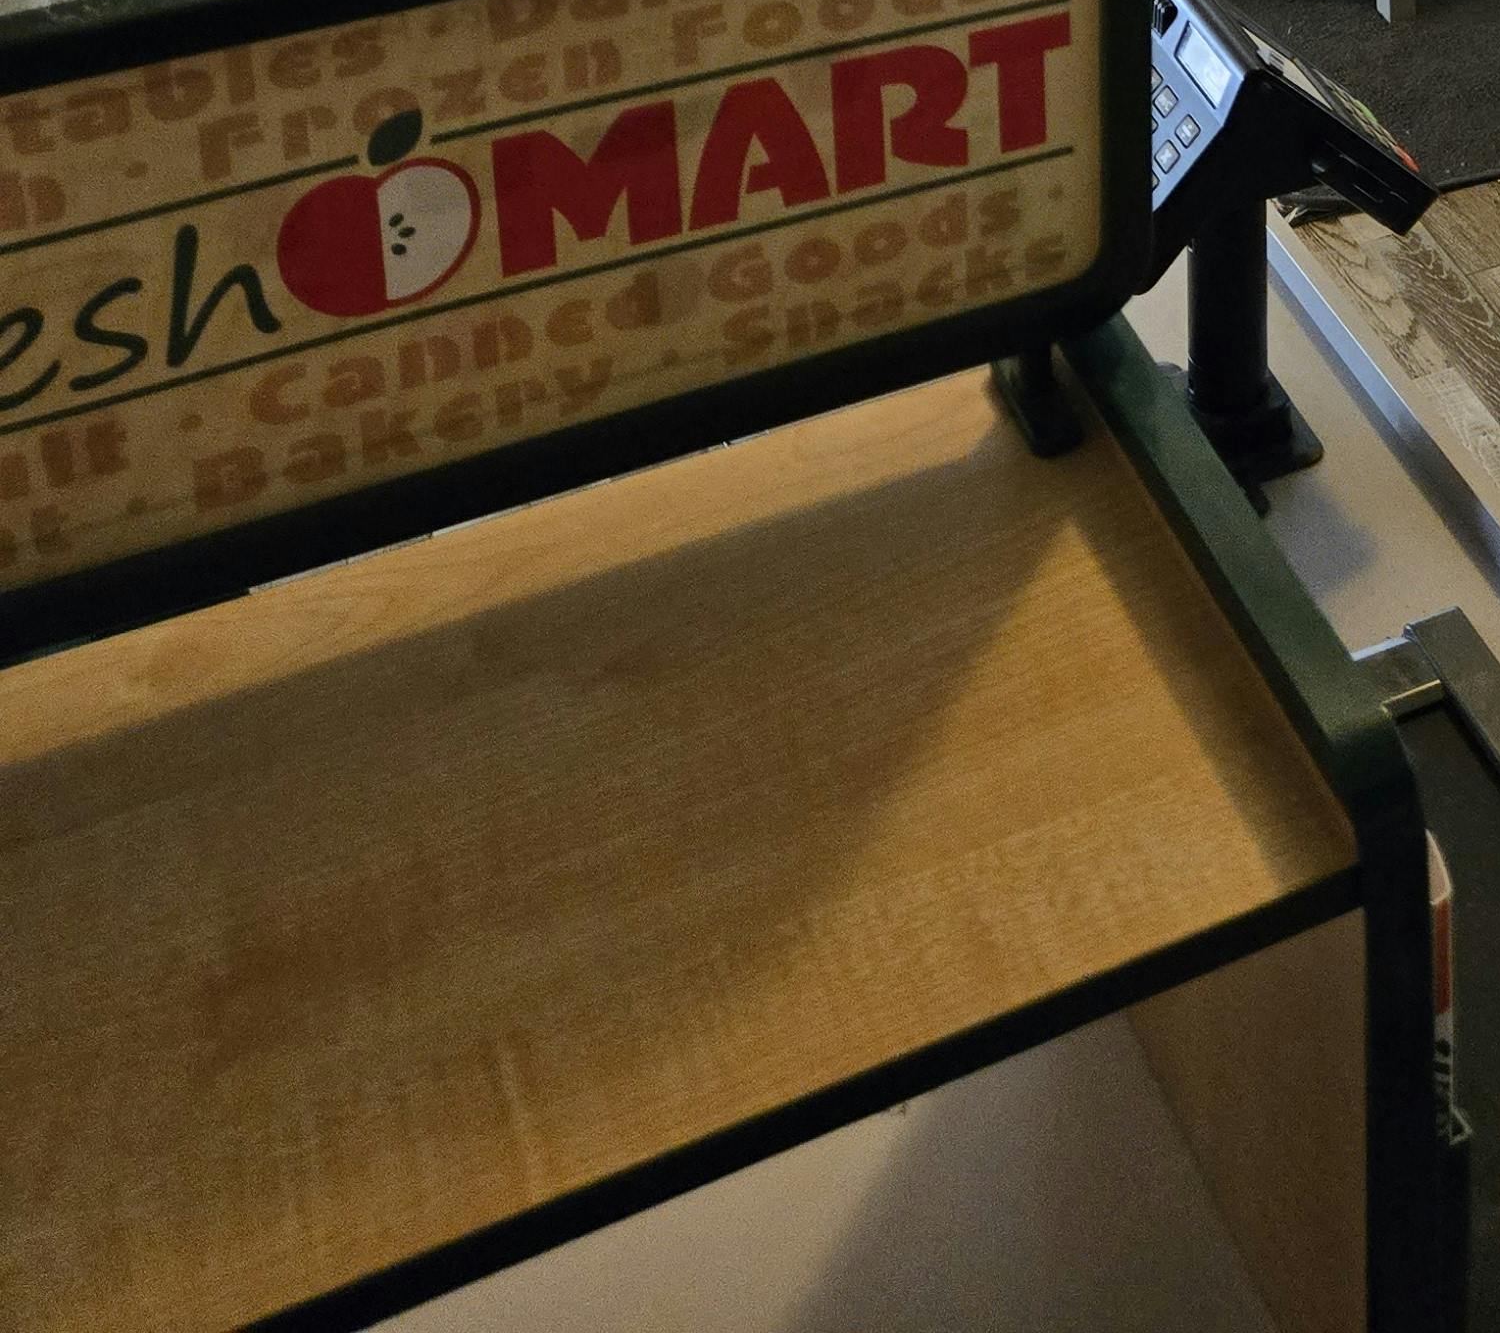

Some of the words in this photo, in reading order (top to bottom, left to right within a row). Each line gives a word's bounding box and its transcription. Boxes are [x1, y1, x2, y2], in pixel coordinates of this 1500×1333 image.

[490, 11, 1072, 279] MART
[195, 355, 614, 511] Bakery
[720, 231, 1068, 368] Snacks
[247, 271, 662, 426] Canned
[707, 188, 1022, 304] Goods
